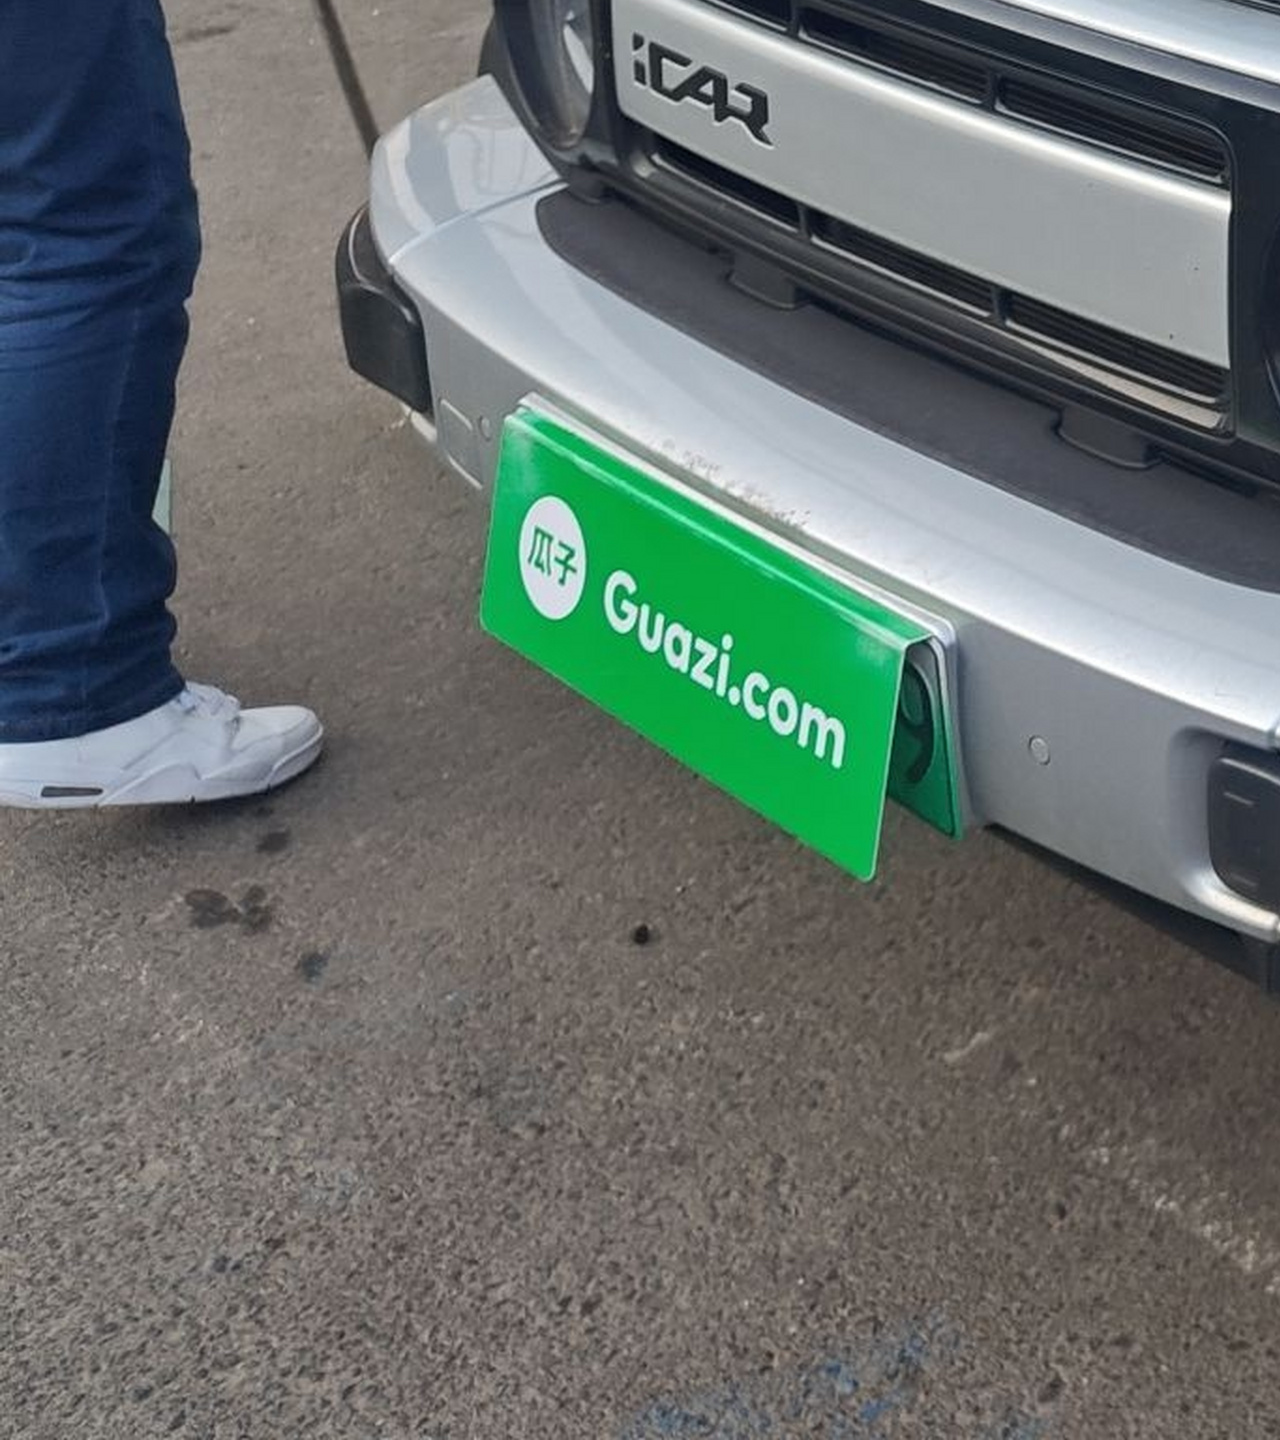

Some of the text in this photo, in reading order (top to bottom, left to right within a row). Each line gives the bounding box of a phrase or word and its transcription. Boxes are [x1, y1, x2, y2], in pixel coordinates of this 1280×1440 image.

[632, 33, 775, 148] iCAR
[527, 525, 578, 586] 瓜子
[602, 568, 847, 770] Guazi.com
